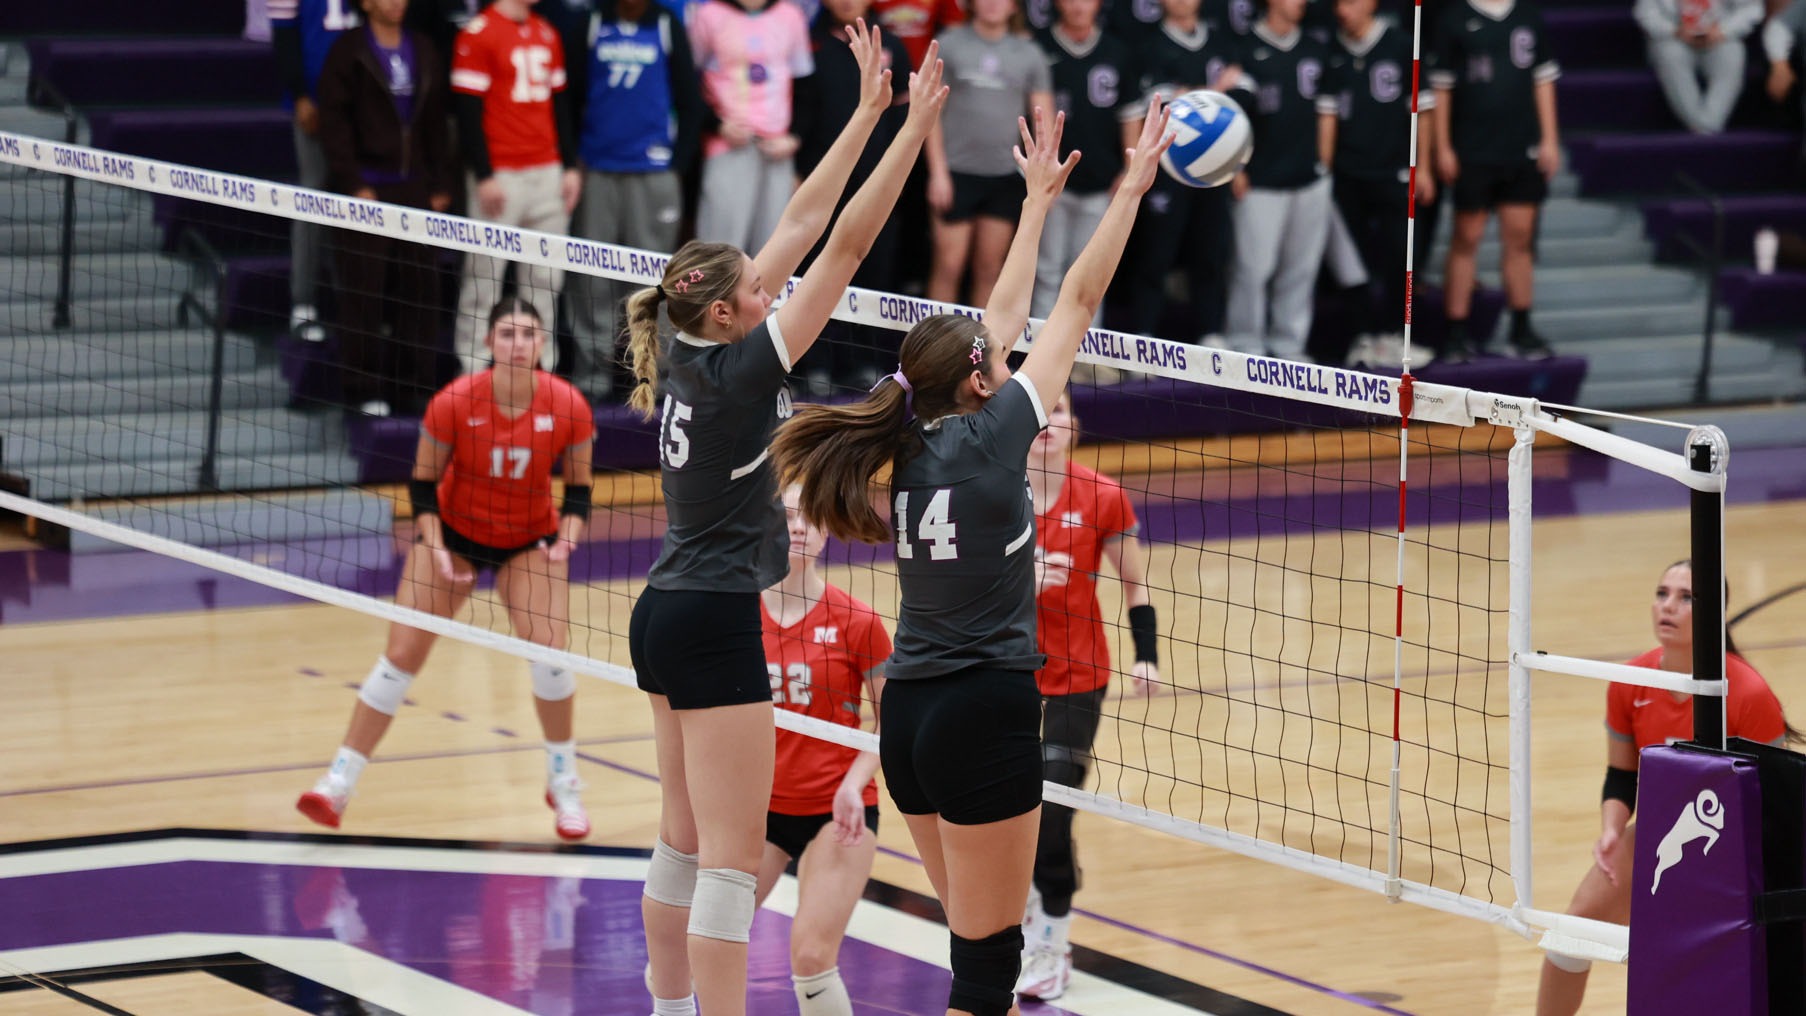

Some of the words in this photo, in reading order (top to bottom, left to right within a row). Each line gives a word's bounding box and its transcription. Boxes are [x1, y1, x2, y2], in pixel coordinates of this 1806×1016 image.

[510, 45, 552, 103] 15
[608, 63, 644, 89] 77
[0, 137, 20, 157] AMS
[33, 143, 40, 160] C
[54, 147, 100, 172] CORNELL
[103, 156, 135, 180] RAMS
[148, 165, 156, 183] C
[170, 169, 219, 196] CORNELL
[222, 178, 255, 202] RAMS
[271, 188, 278, 206] C
[294, 192, 346, 219] CORNELL
[349, 202, 385, 227] RAMS
[401, 212, 409, 231] C
[426, 217, 481, 245] CORNELL
[485, 227, 522, 253] RAMS
[540, 238, 549, 257] C
[566, 242, 626, 272] CORNELL
[849, 293, 857, 312] C
[1024, 323, 1032, 342] C
[1136, 339, 1187, 371] RAMS
[1212, 353, 1221, 375] C
[1246, 357, 1328, 395] CORNELL
[1335, 372, 1391, 404] RAMS
[1500, 401, 1521, 411] Senoh
[490, 447, 531, 479] 17
[894, 489, 958, 561] 14
[813, 626, 838, 643] M
